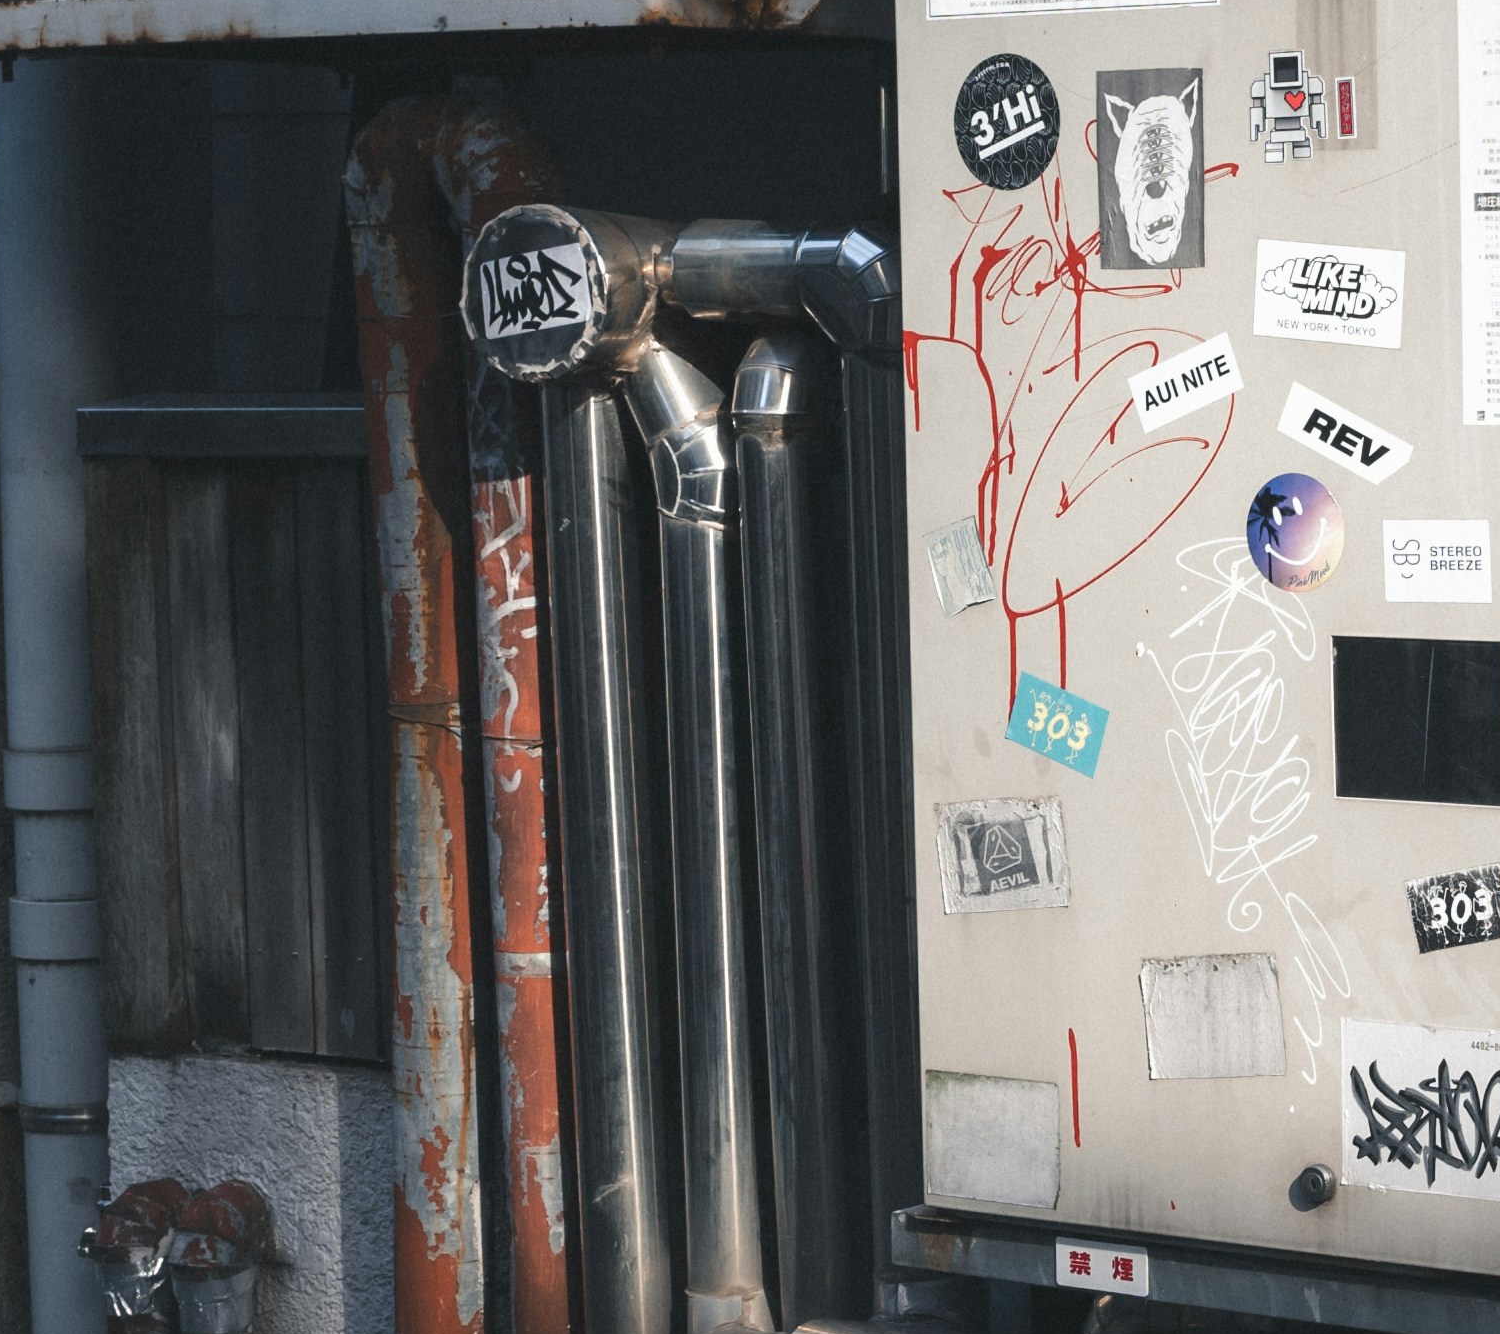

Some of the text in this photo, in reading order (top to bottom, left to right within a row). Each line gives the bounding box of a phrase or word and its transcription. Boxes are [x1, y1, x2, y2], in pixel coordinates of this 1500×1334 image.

[970, 84, 1042, 147] 3'Hi
[1290, 256, 1364, 290] LIKE
[1302, 287, 1376, 319] MIND
[1277, 318, 1377, 337] NEW YORK TOKYO
[1144, 354, 1231, 412] AUI NITE
[1303, 408, 1391, 468] REV
[1430, 545, 1482, 558] STEREO
[1430, 559, 1482, 572] BREEZE
[1026, 701, 1092, 752] 303
[990, 872, 1030, 892] AEVIL
[1428, 882, 1495, 930] 303
[1067, 1249, 1136, 1283] 禁煙
